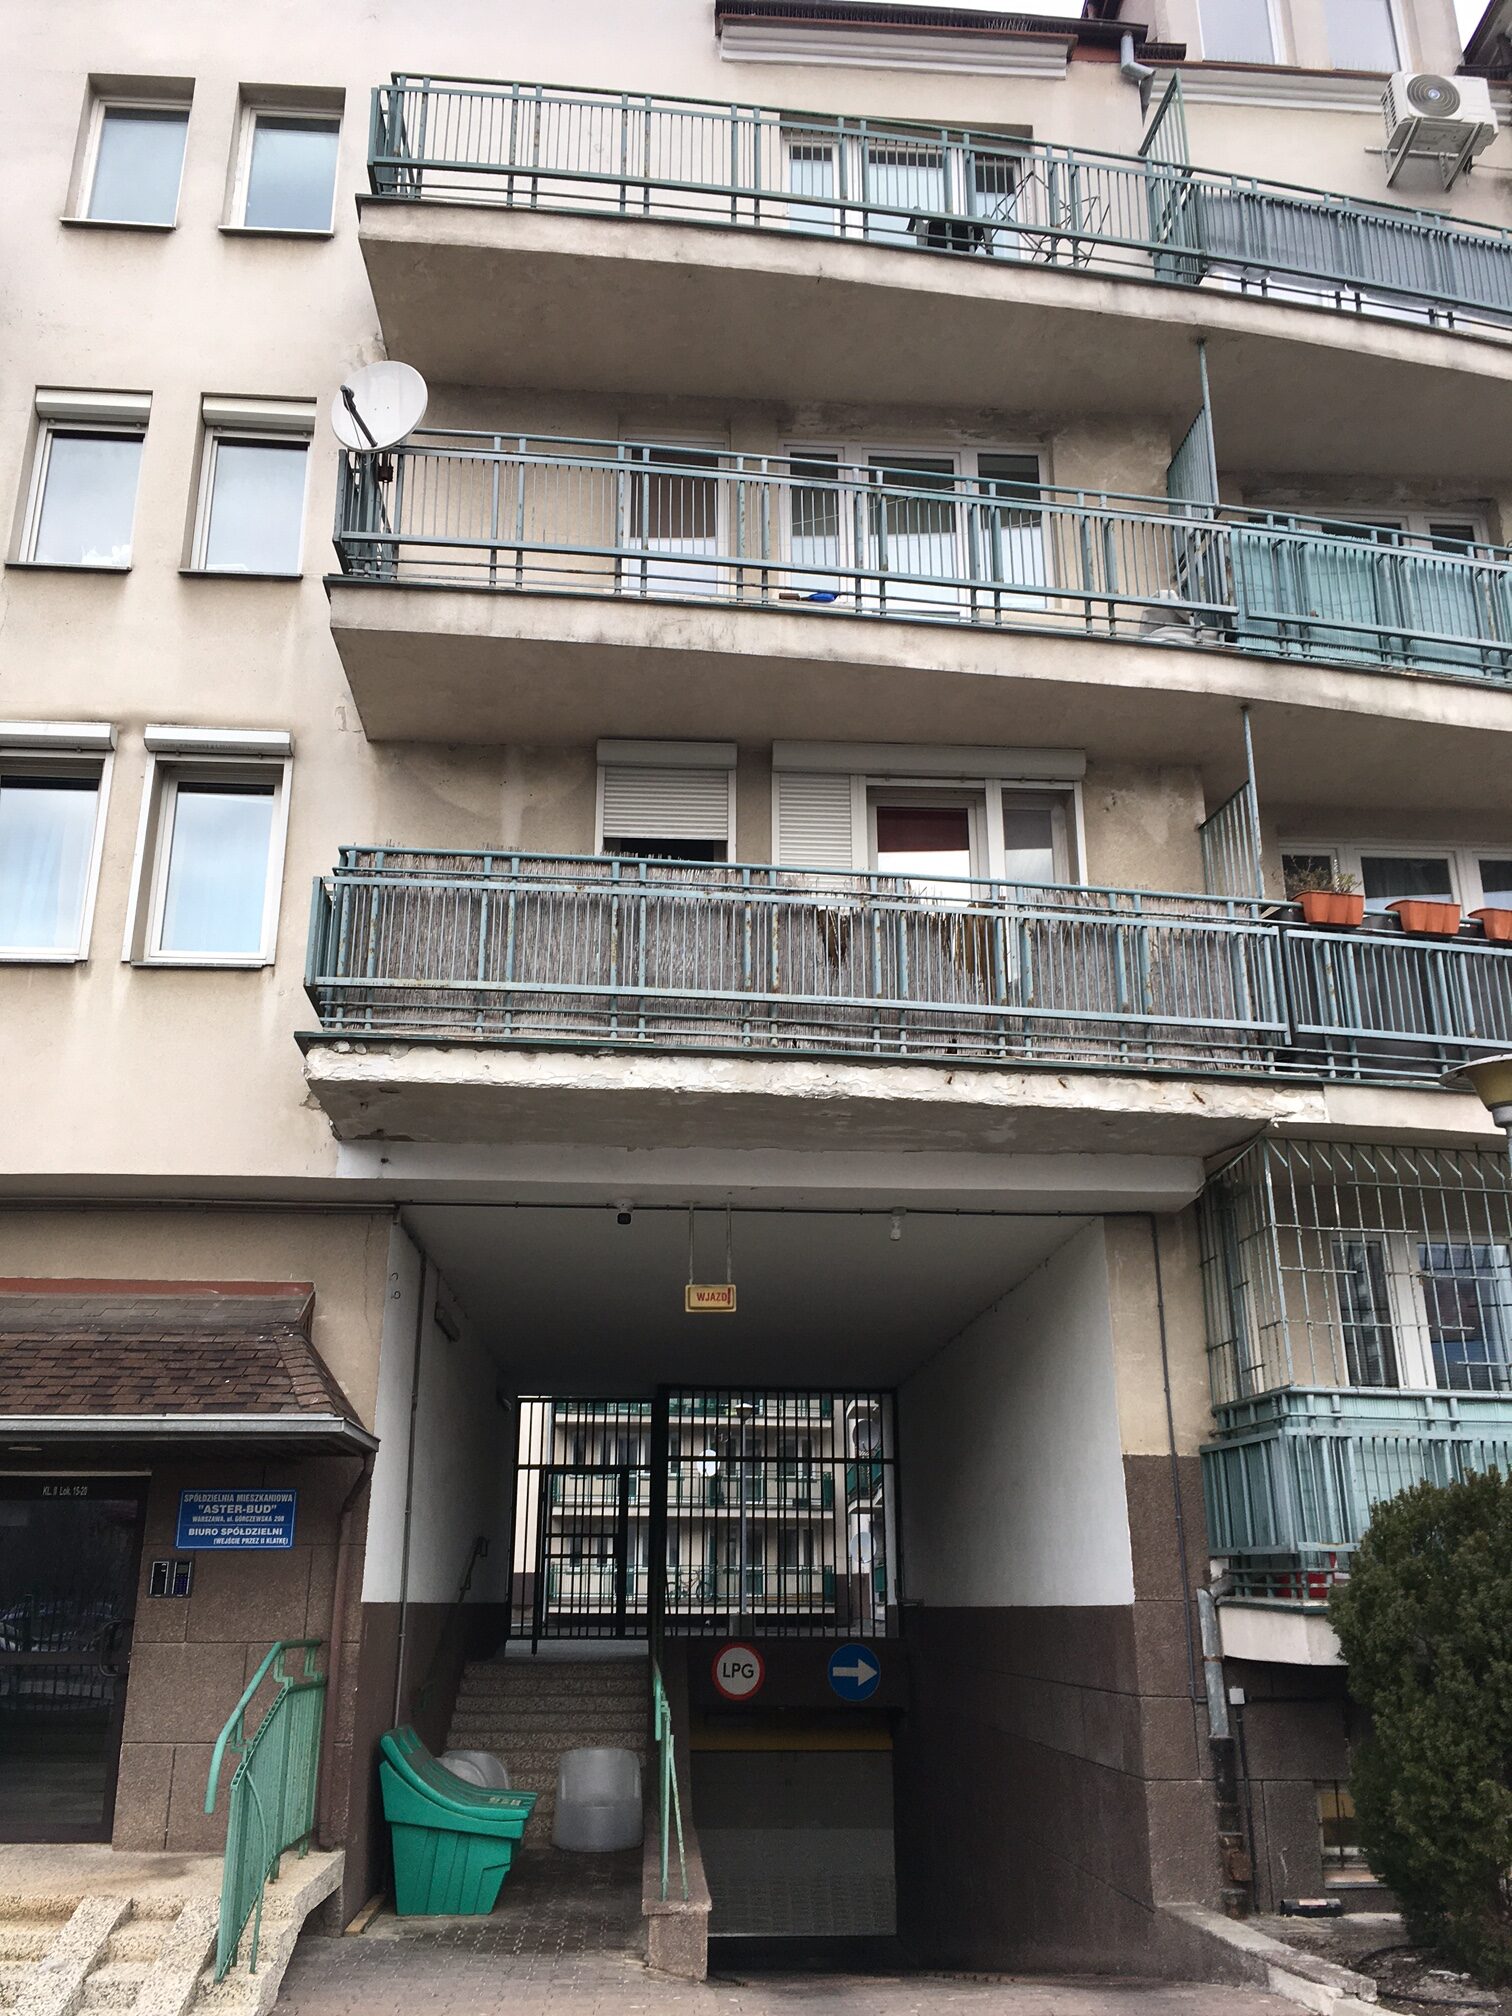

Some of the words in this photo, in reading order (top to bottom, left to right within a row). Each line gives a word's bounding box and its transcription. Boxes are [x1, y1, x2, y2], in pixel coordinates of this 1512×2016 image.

[696, 1292, 728, 1301] WJAZD
[184, 1493, 235, 1503] SPÓŁDZIELNIA
[236, 1494, 293, 1502] MIESZKANIOWA
[198, 1504, 277, 1514] "ASTER-BUD"
[188, 1528, 219, 1536] BIURO
[220, 1526, 283, 1536] SPÓŁDZIELNI
[722, 1662, 754, 1679] LPG
